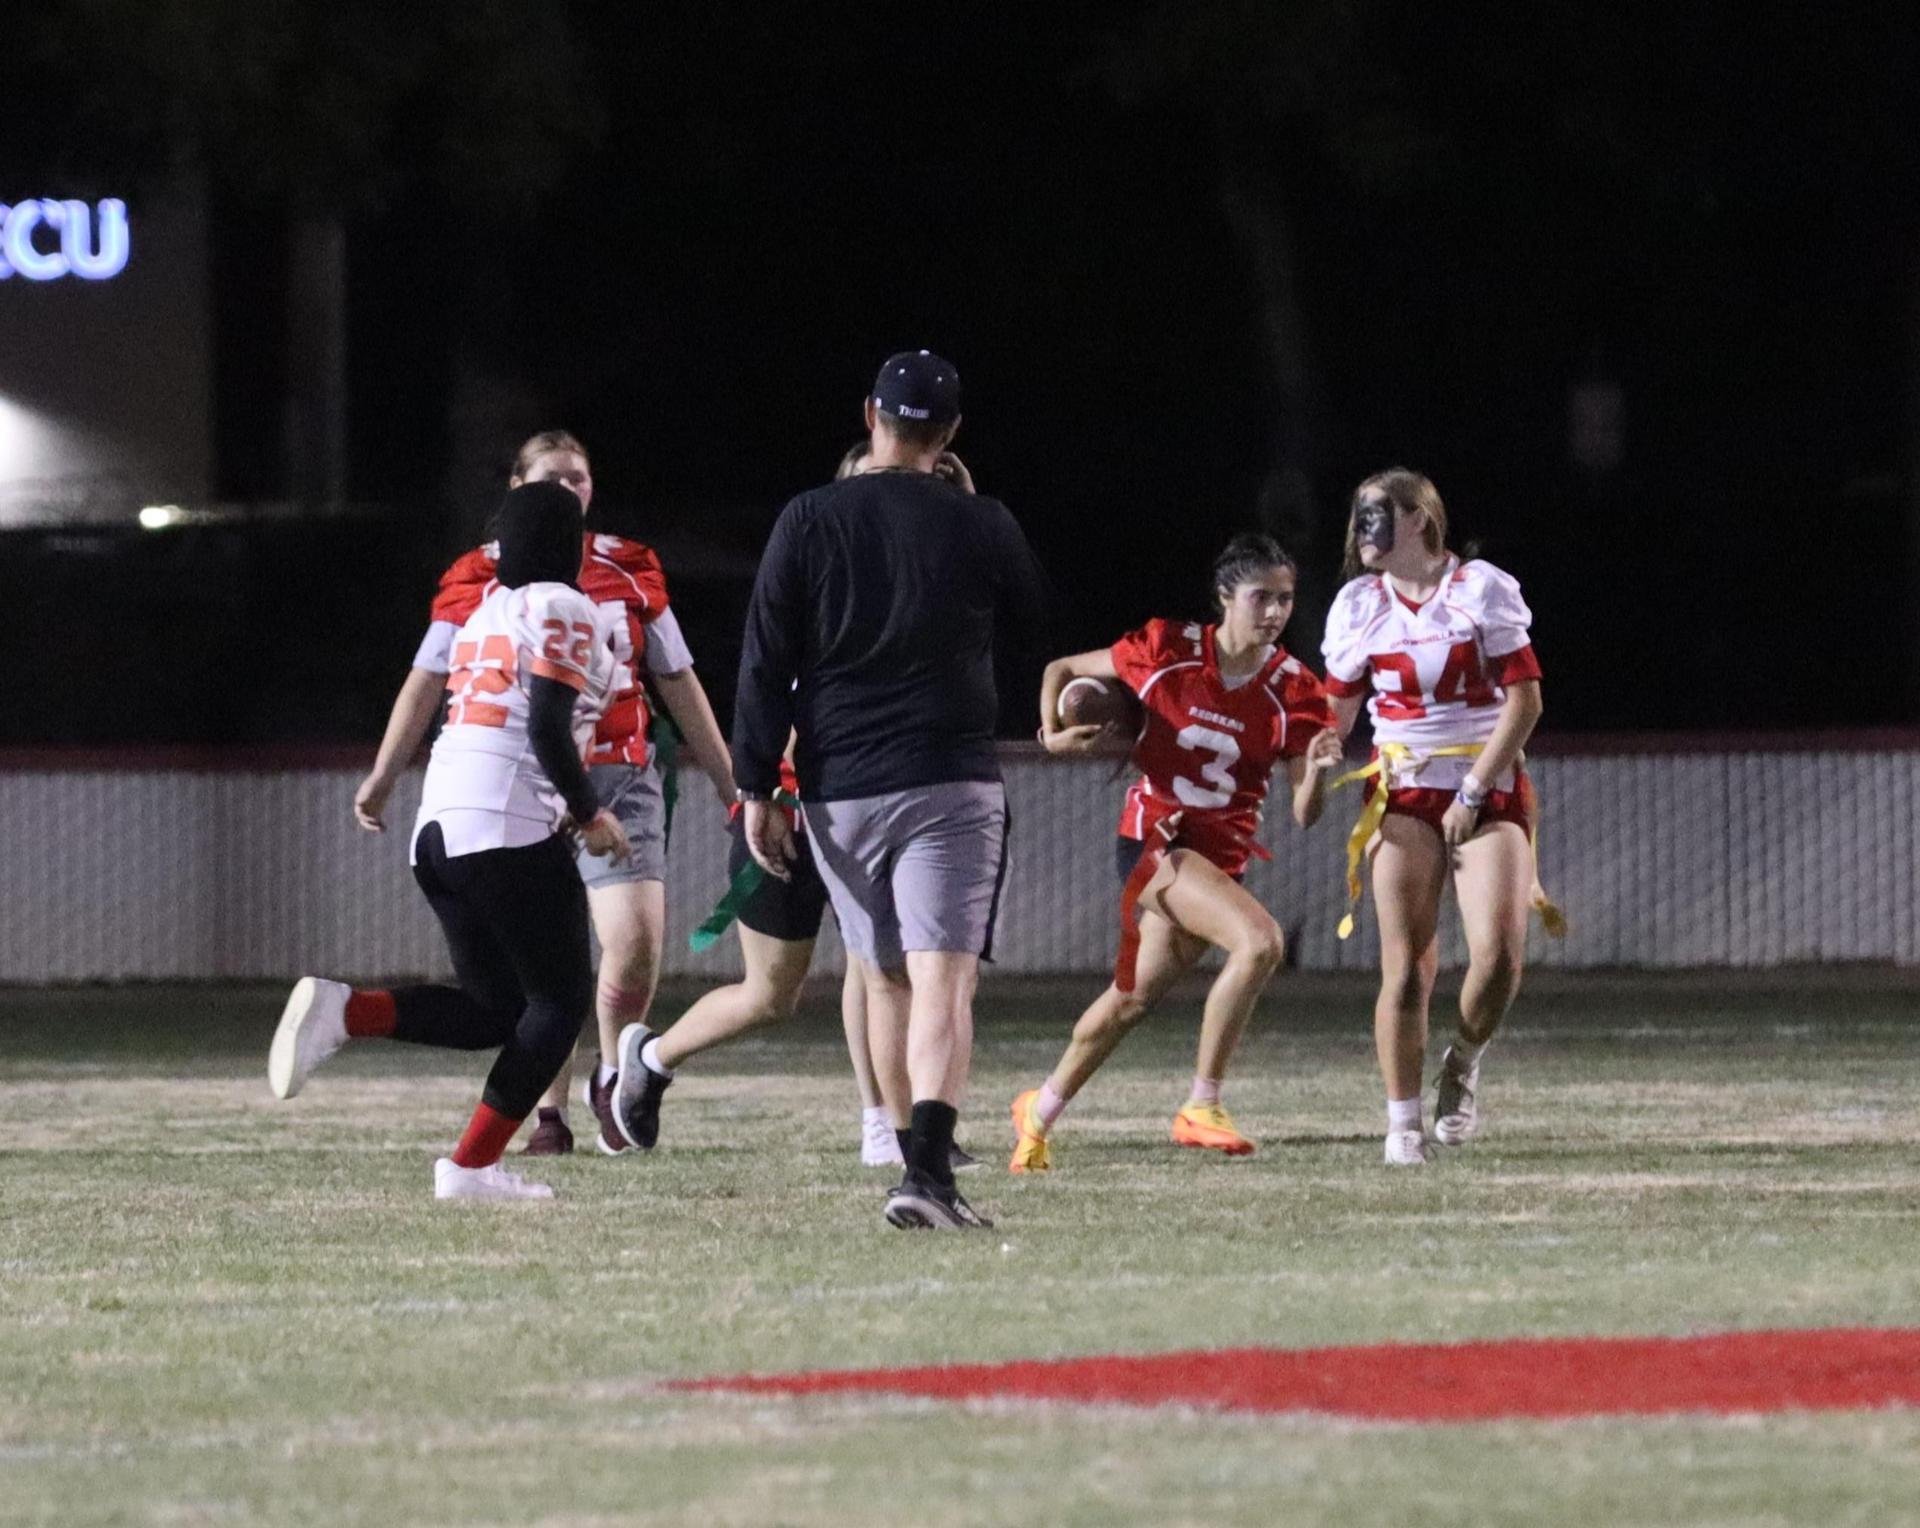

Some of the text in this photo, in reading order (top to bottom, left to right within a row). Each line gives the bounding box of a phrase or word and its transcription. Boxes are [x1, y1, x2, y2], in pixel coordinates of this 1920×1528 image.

[0, 198, 129, 280] CU
[542, 618, 594, 667] 22
[1172, 723, 1241, 809] 3
